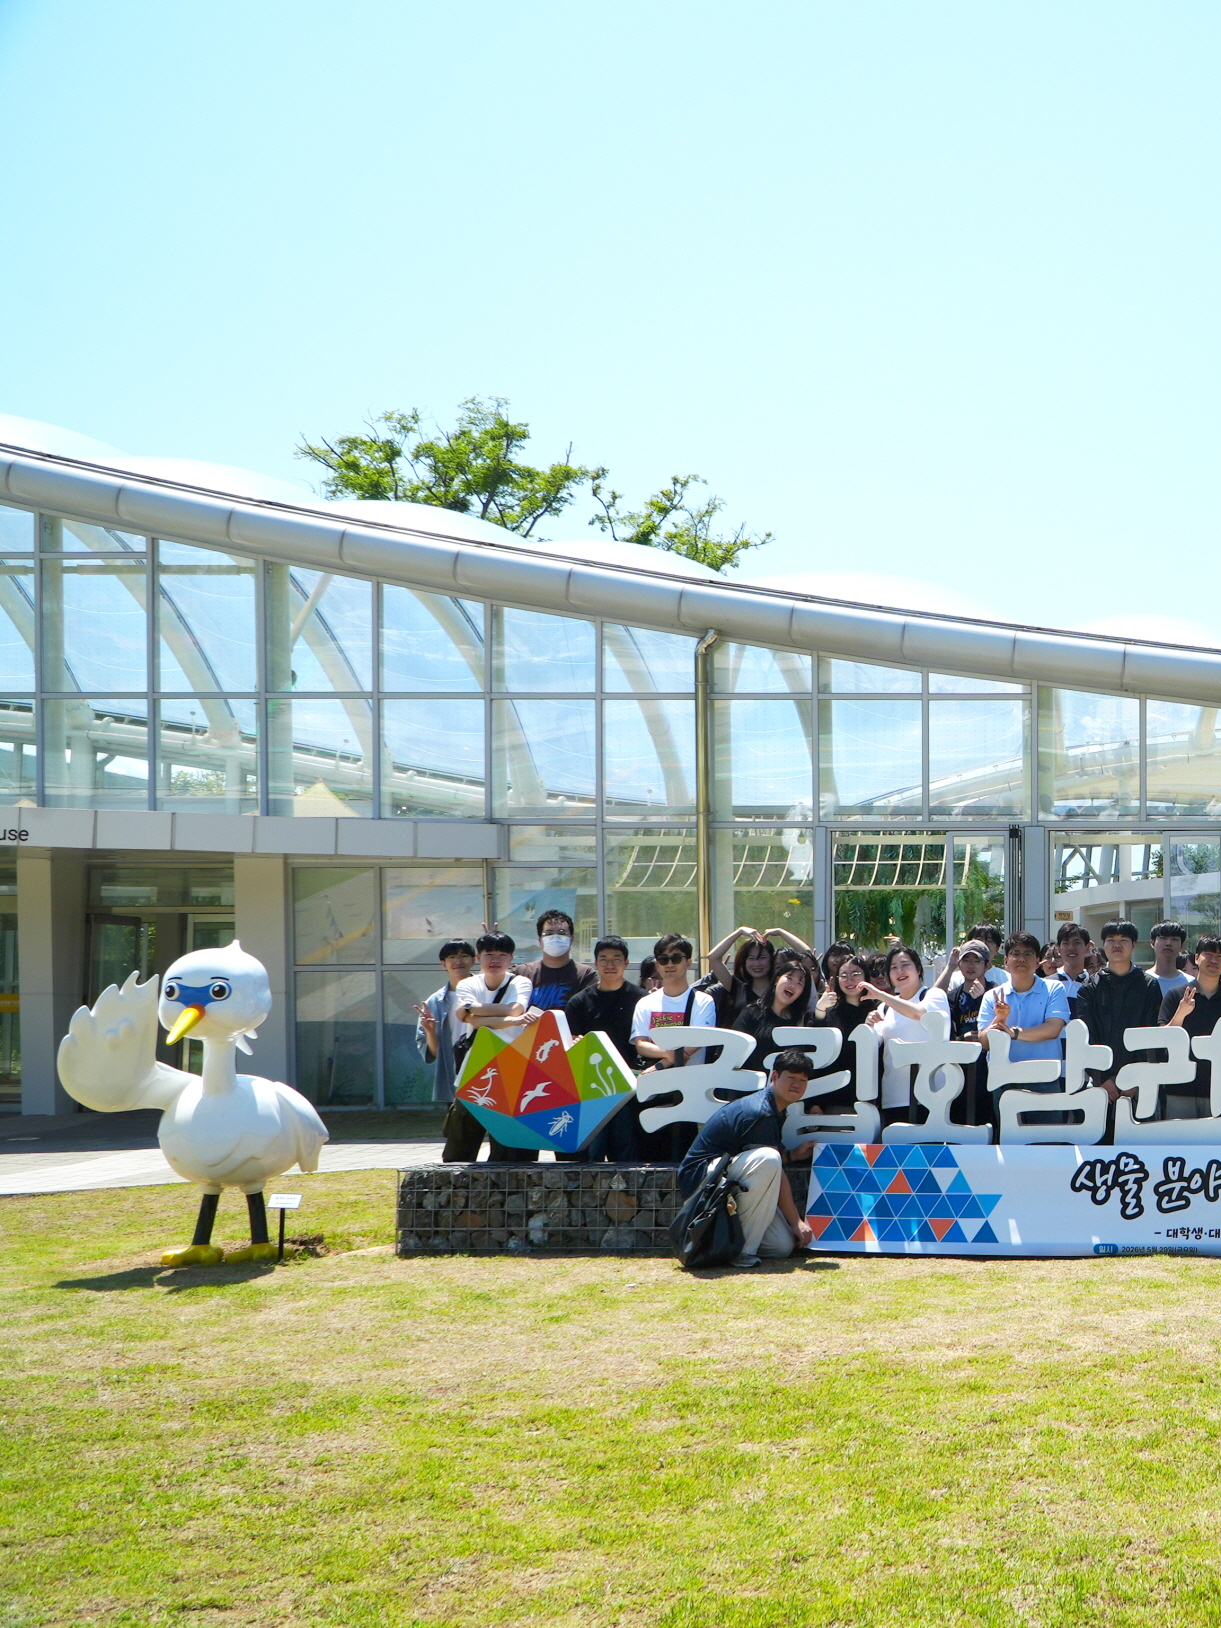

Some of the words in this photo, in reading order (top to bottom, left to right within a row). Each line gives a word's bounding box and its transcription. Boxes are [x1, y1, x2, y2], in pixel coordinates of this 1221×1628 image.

[652, 1013, 674, 1023] Jackie
[1071, 1152, 1149, 1220] 생물
[1099, 1245, 1113, 1254] 일시
